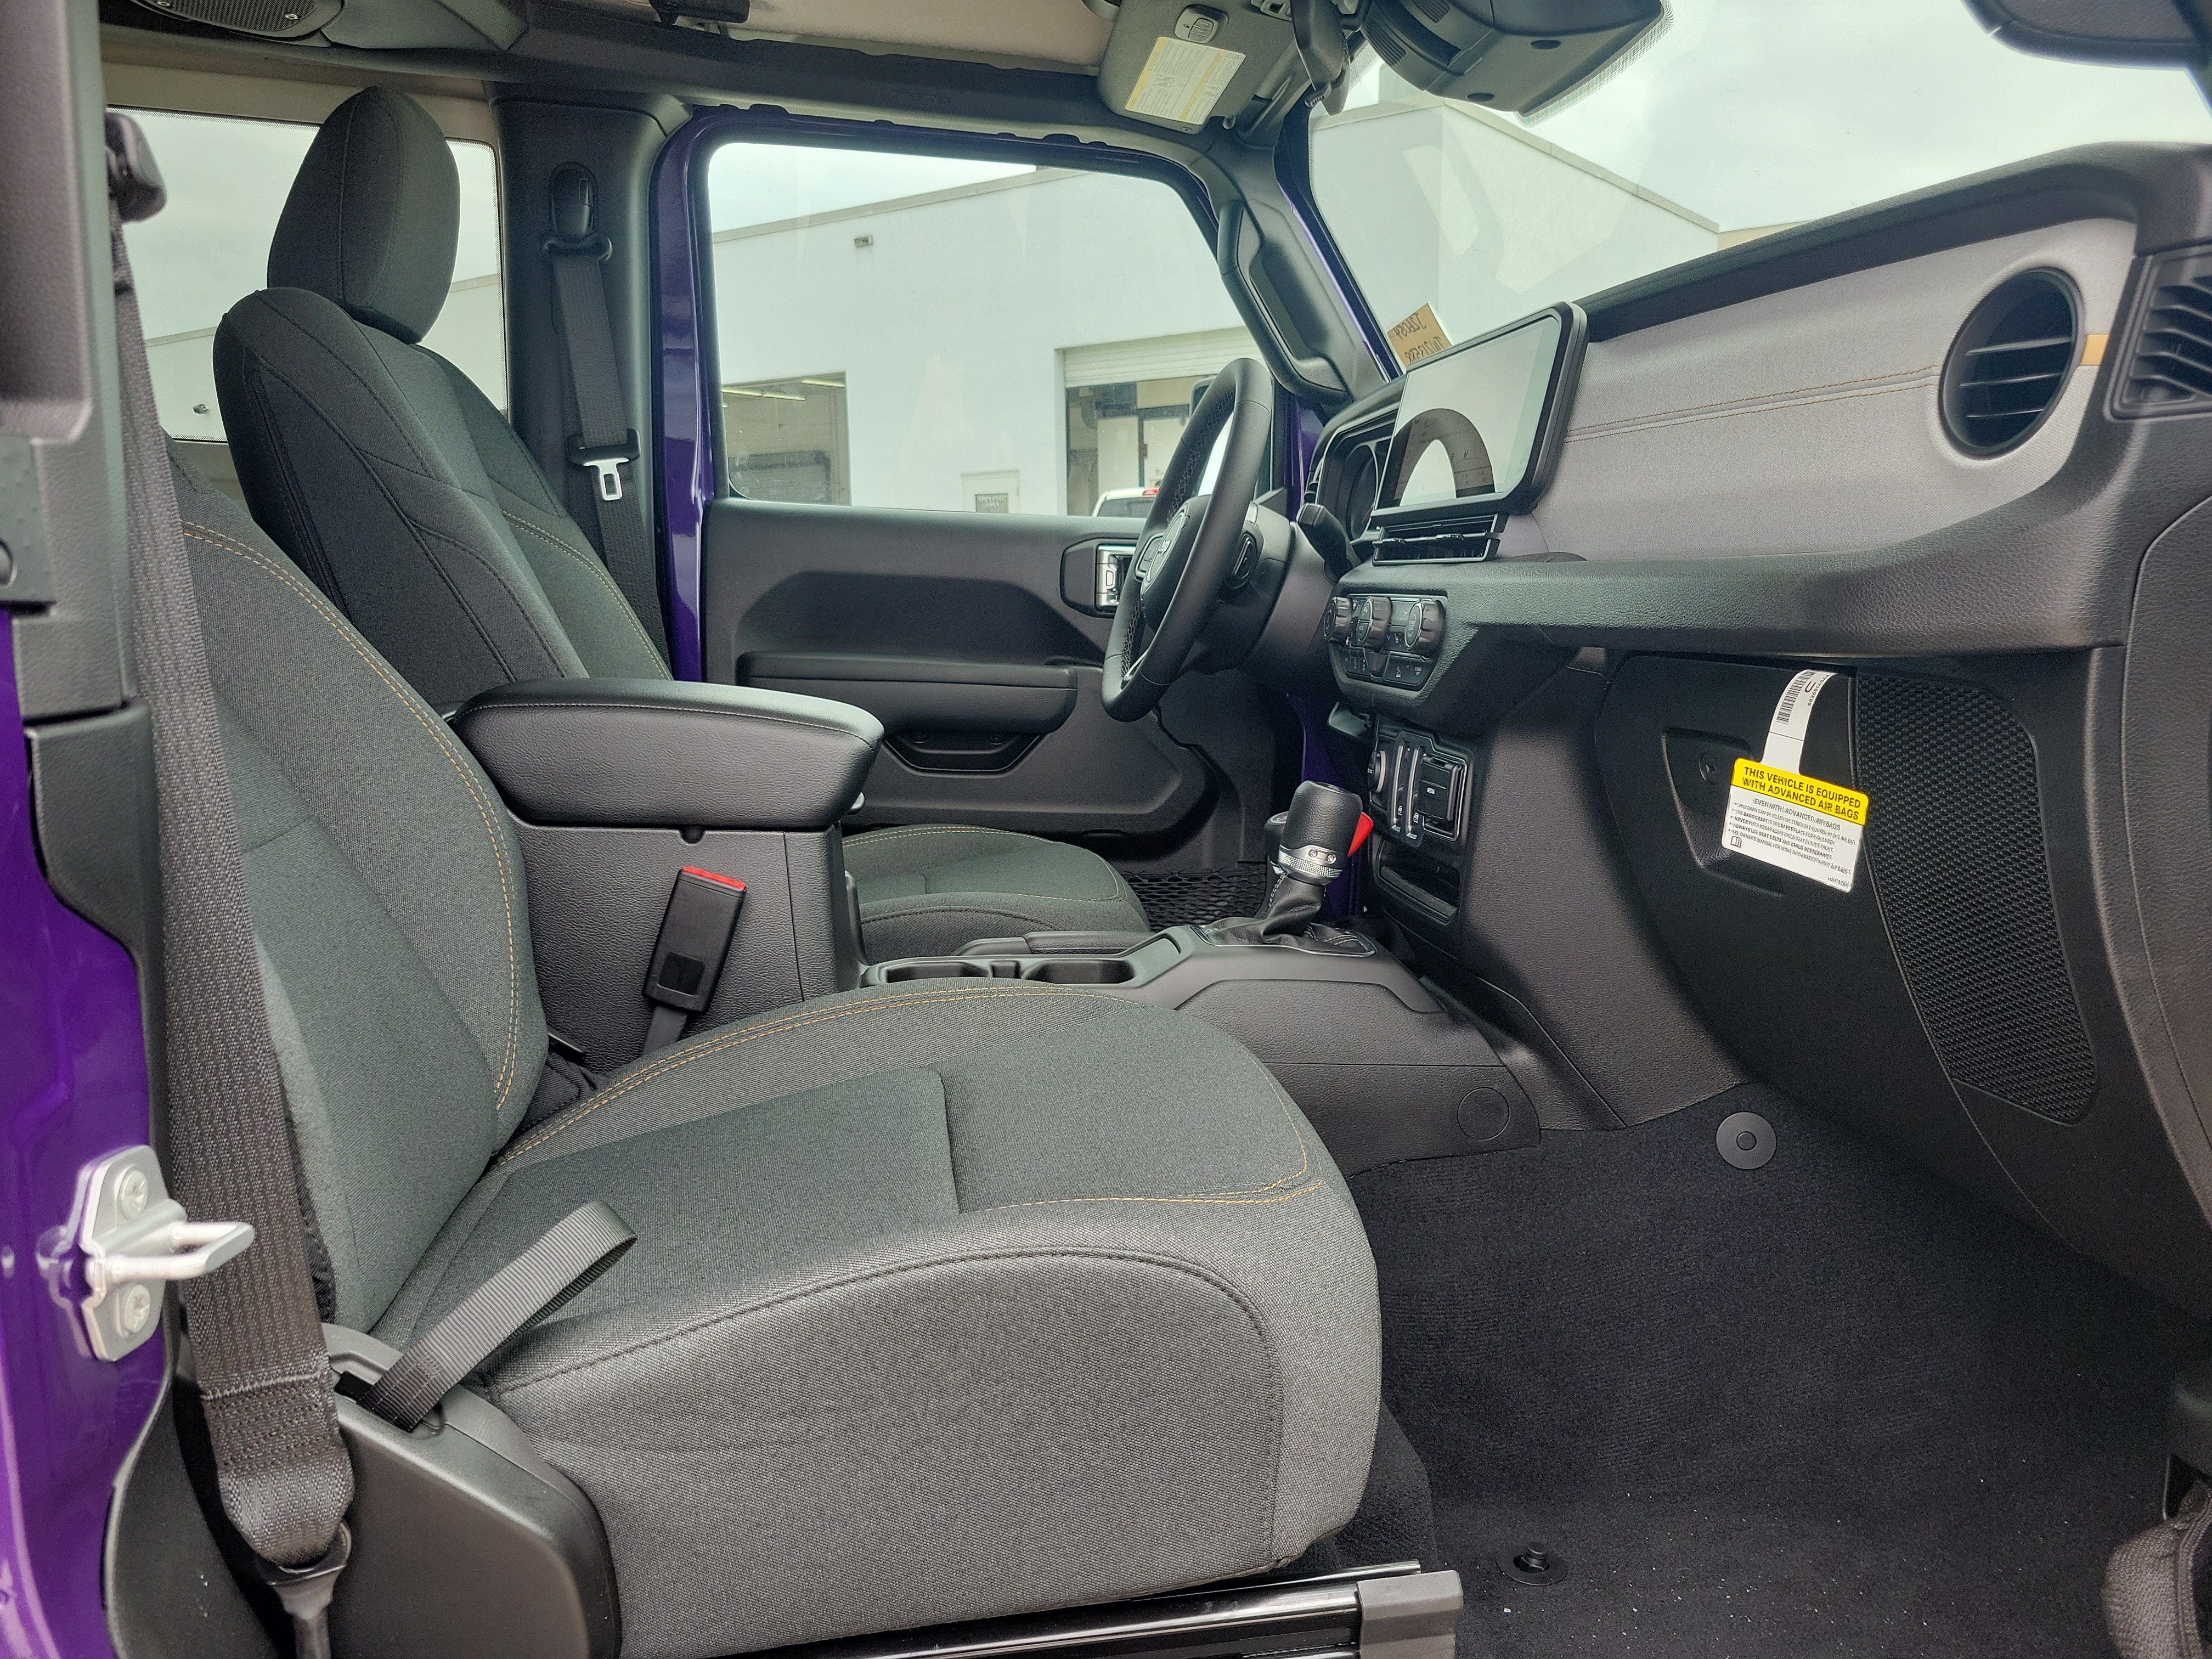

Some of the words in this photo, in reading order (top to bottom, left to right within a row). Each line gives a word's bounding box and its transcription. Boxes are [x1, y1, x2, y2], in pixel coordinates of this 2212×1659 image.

[1742, 777, 1765, 791] WITH
[1768, 785, 1816, 806] ADVANCED
[1818, 800, 1832, 811] AIR
[1835, 805, 1859, 820] BAGS
[1744, 767, 1764, 779] THIS
[1767, 773, 1804, 791] VEHICLE
[1805, 785, 1814, 794] IS
[1816, 788, 1861, 808] EQUIPPED
[1733, 823, 1750, 832] ALWAYS
[1737, 803, 1757, 812] CHILDREN
[1791, 820, 1811, 830] SERIOUSLY
[1811, 826, 1826, 835] INJURED
[1753, 798, 1769, 807] EVEN
[1770, 803, 1784, 812] WITH
[1785, 808, 1815, 822] ADVANCED
[1826, 821, 1840, 831] BAGS
[1780, 823, 1795, 832] SAFEST
[1740, 832, 1756, 841] OWNER'S
[1757, 838, 1771, 847] MANUAL
[1792, 850, 1817, 862] INFORMATION
